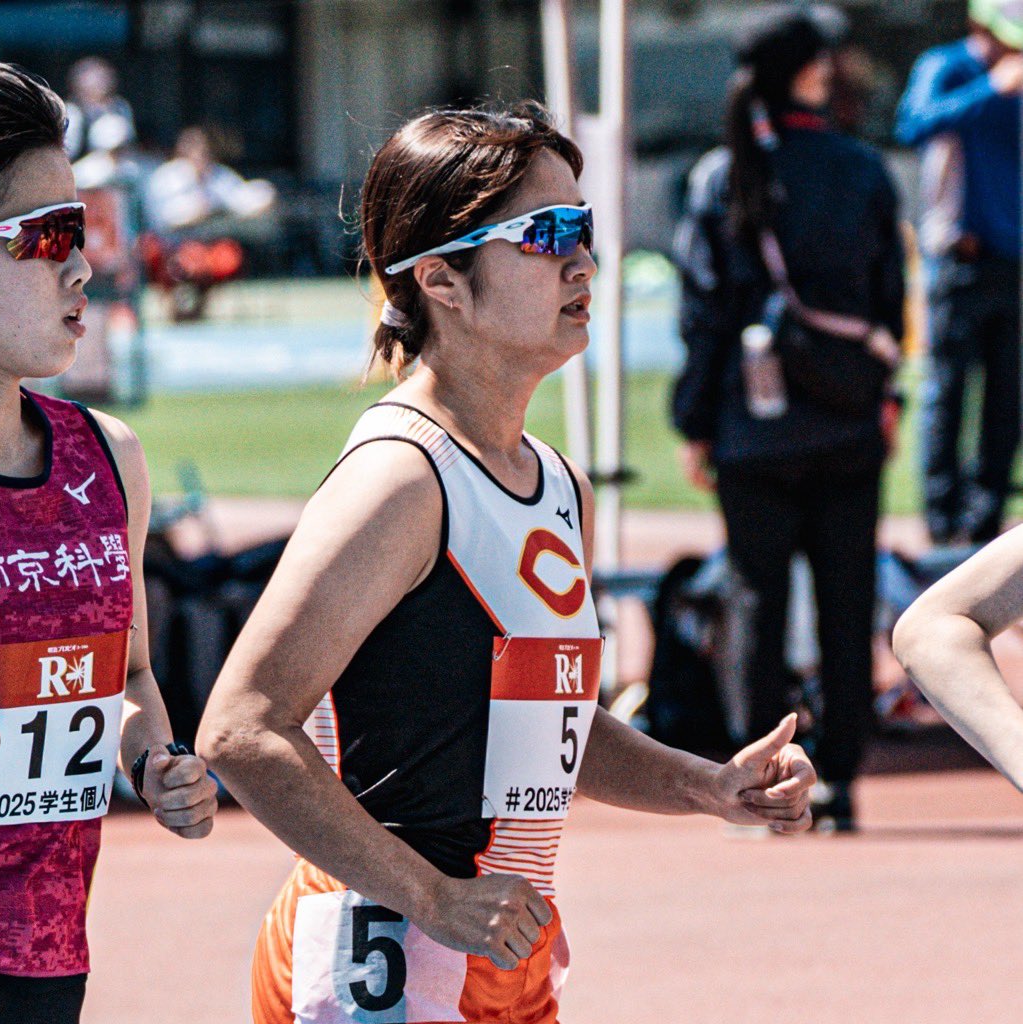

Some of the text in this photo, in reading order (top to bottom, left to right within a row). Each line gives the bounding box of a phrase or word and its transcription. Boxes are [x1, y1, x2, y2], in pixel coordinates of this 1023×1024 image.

[517, 527, 586, 620] C
[21, 705, 106, 779] 12
[560, 706, 579, 774] 5
[349, 905, 407, 1012] 5
